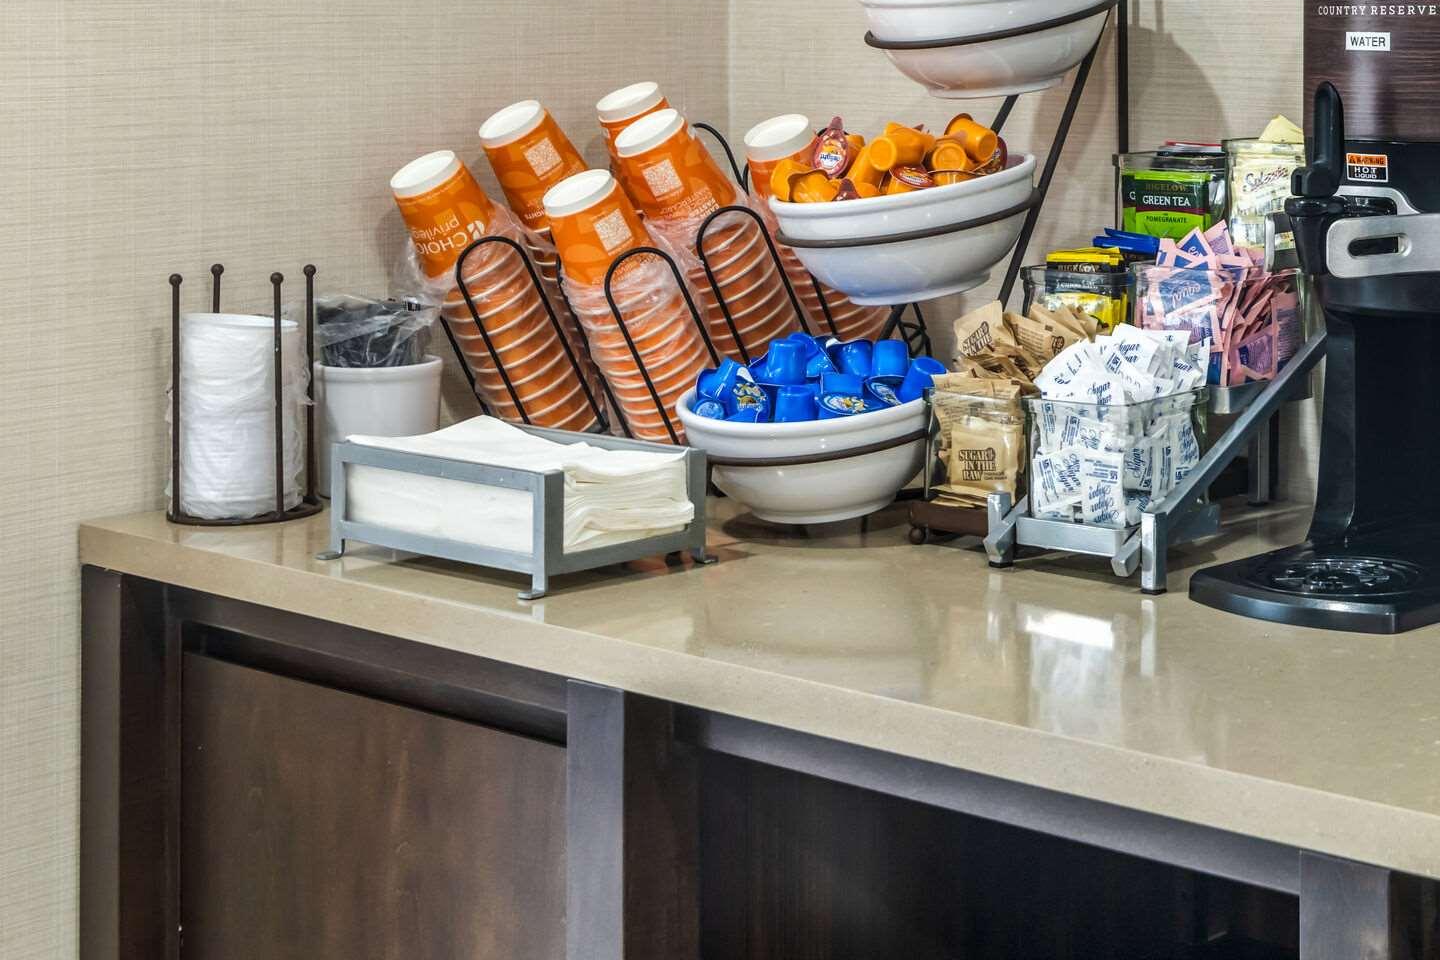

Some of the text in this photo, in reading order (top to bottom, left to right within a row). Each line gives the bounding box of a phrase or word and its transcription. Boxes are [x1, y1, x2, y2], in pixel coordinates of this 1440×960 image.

[1318, 5, 1367, 16] COUNTRY
[1350, 36, 1386, 47] WATER
[1354, 166, 1378, 174] HOT
[1142, 195, 1171, 207] GREEN
[1172, 196, 1192, 207] TEA
[1146, 215, 1187, 224] POMEGRANATE
[416, 231, 469, 255] CHOIC
[959, 450, 988, 461] SUGAR
[964, 461, 996, 471] IN THE
[963, 471, 983, 481] RAW
